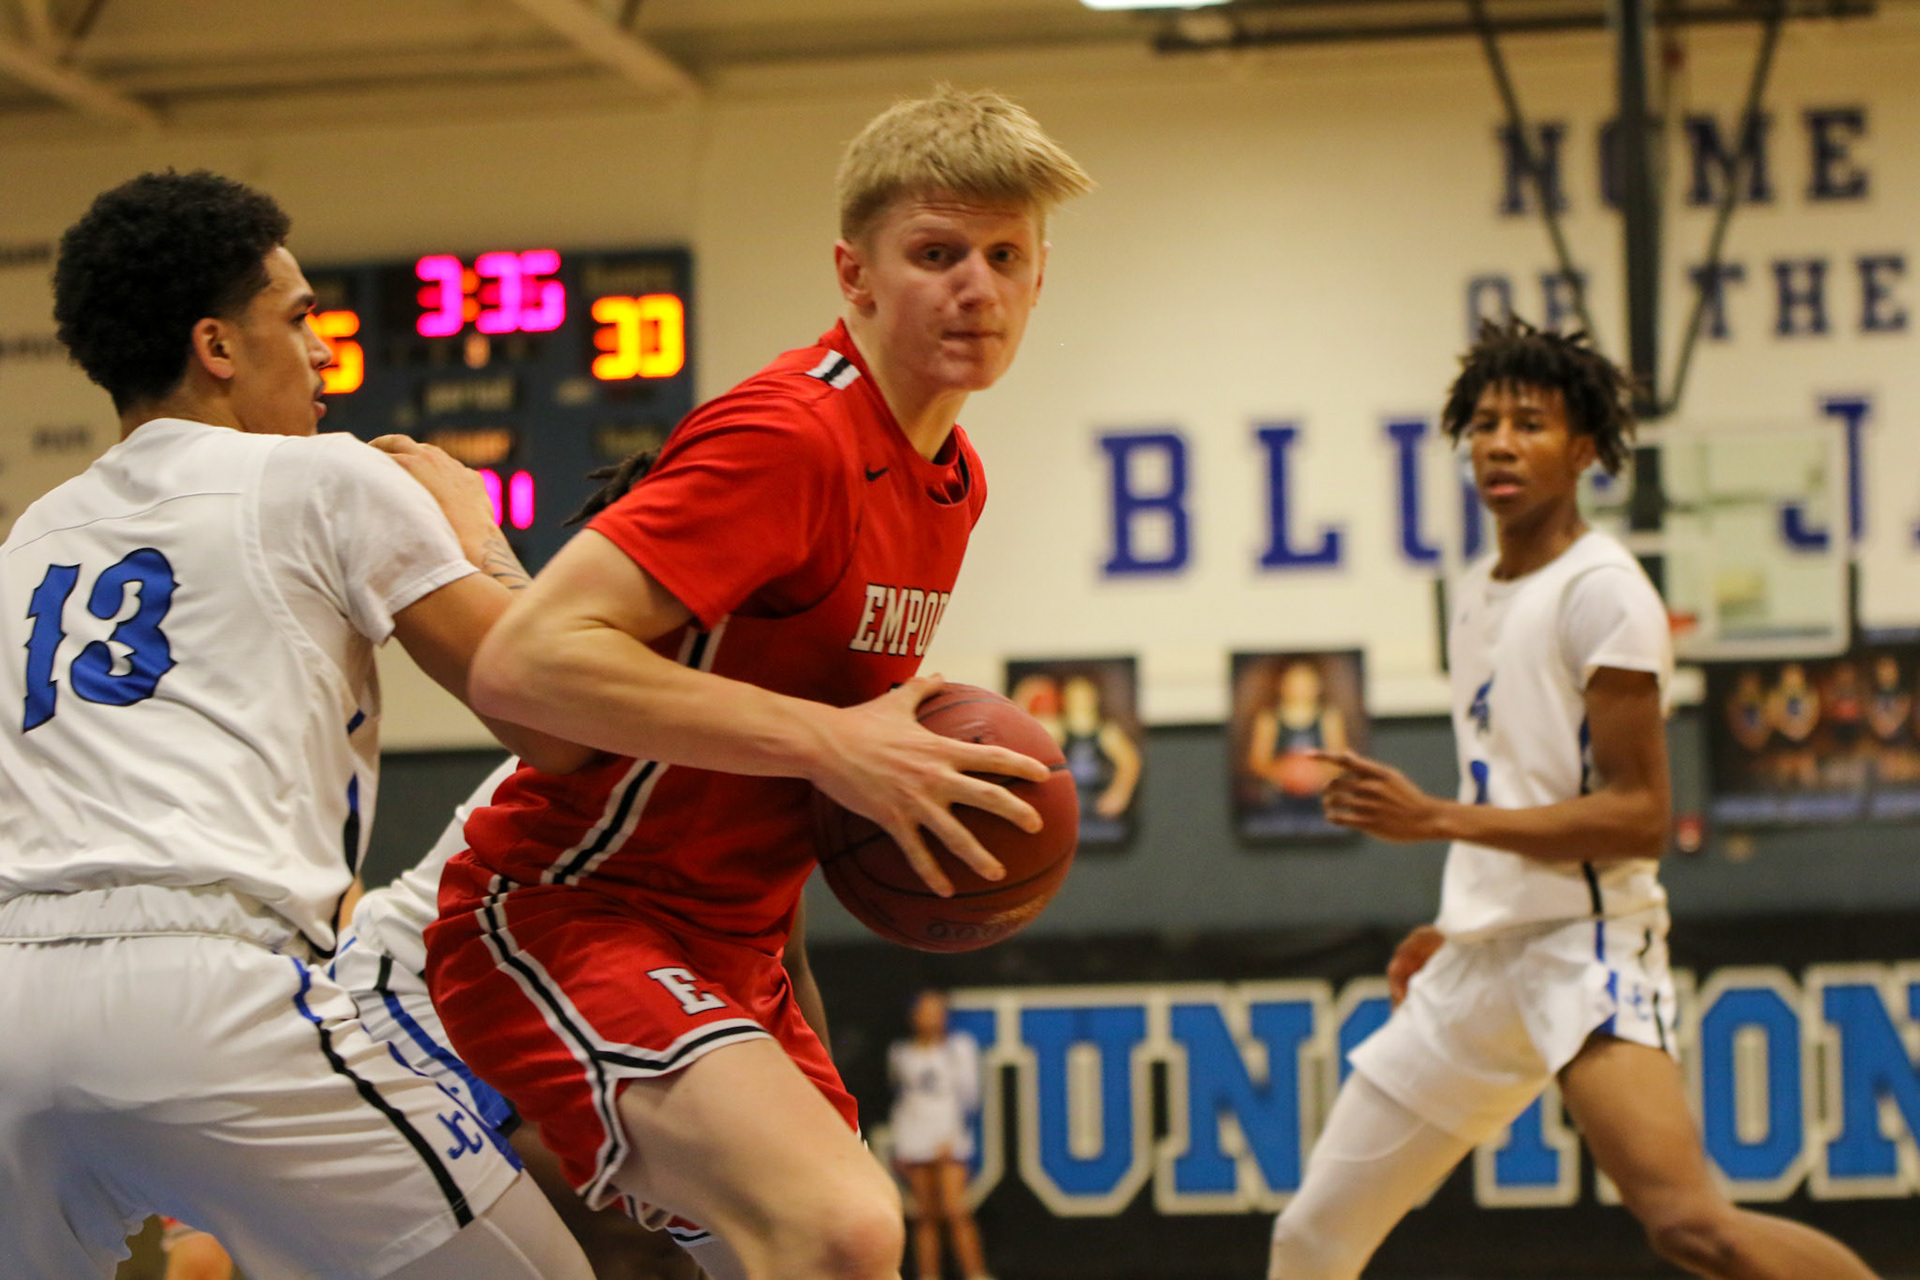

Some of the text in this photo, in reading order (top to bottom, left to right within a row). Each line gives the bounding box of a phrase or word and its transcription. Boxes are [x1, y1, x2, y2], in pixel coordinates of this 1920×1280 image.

[1691, 255, 1907, 340] THE
[305, 310, 364, 394] 5
[21, 547, 182, 735] 13
[646, 966, 729, 1016] E
